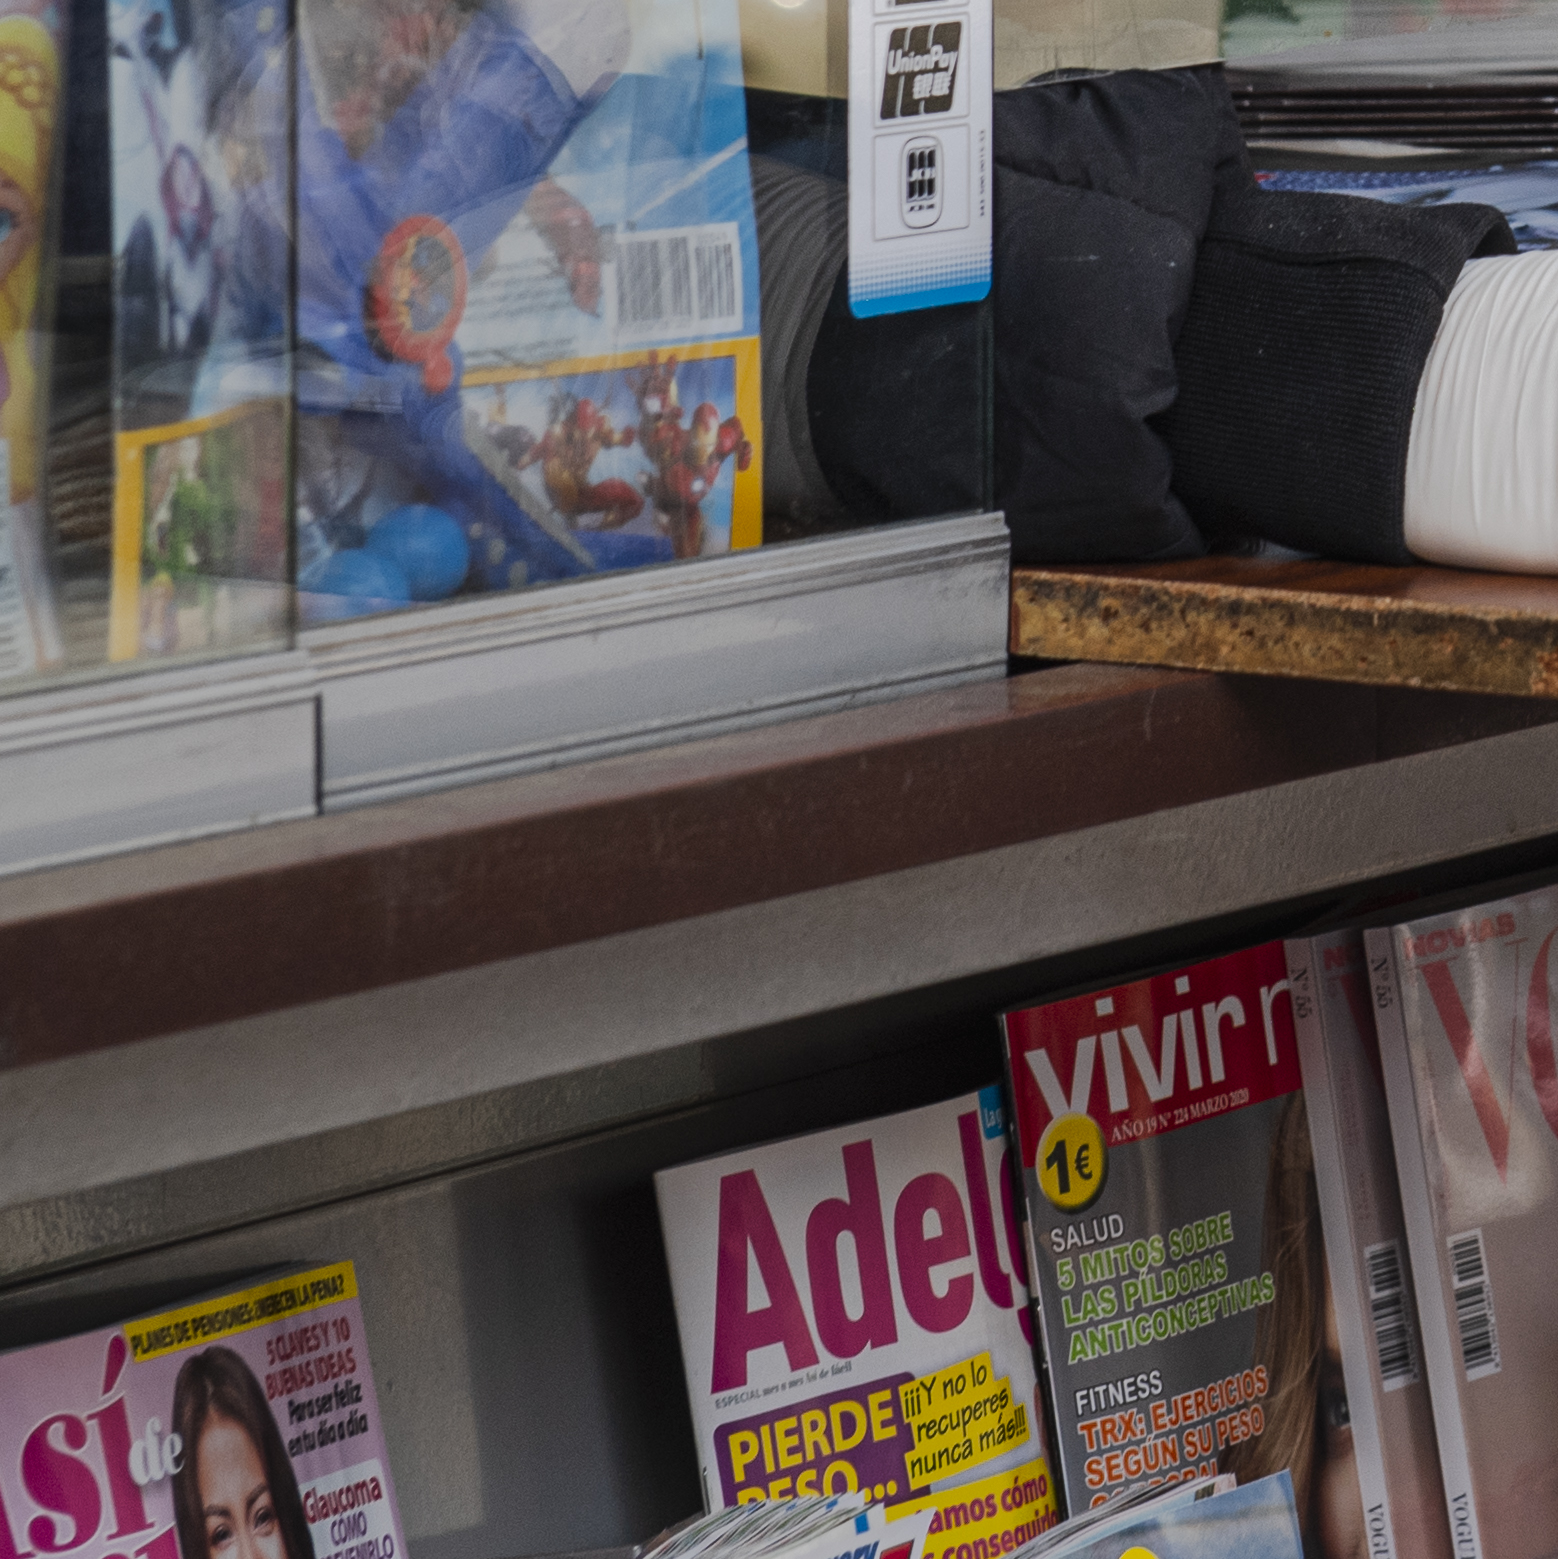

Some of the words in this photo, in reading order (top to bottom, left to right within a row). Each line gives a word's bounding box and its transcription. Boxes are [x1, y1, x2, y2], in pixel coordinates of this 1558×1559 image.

[887, 44, 959, 76] UnionPay
[1410, 912, 1517, 959] NOVIAS
[1023, 974, 1247, 1120] vivir
[1110, 1118, 1144, 1144] AÑO
[1188, 1094, 1229, 1124] MARZO
[1228, 1086, 1249, 1110] 2020
[1044, 1138, 1094, 1197] 1€
[1050, 1213, 1125, 1254] SALUD
[1056, 1256, 1077, 1292] 5
[1079, 1234, 1167, 1286] MITOS
[1168, 1211, 1234, 1261] SOBRE
[1061, 1286, 1118, 1329] LAS
[1121, 1251, 1229, 1313] PÍLDORAS
[130, 1325, 173, 1357] PLANES
[174, 1321, 192, 1346] DE
[266, 1340, 276, 1365] 5
[275, 1326, 321, 1363] CLAVES
[319, 1323, 330, 1350] Y
[331, 1316, 351, 1345] 10
[1067, 1271, 1276, 1366] ANTICONCEPTIVAS
[264, 1361, 315, 1400] BUENAS
[314, 1346, 357, 1386] IDEAS
[941, 1373, 967, 1398] no
[969, 1360, 988, 1387] lo
[1075, 1369, 1163, 1417] FITNESS
[287, 1396, 315, 1427] Para
[332, 1379, 363, 1413] feliz
[346, 1409, 369, 1439] día
[915, 1387, 1011, 1443] recuperes
[1077, 1408, 1147, 1454] TRX:
[1150, 1364, 1269, 1435] EJERCICIOS
[128, 1416, 185, 1489] de
[727, 1388, 898, 1484] PIERDE
[908, 1439, 975, 1480] nunca
[978, 1404, 1028, 1453] más!!!
[1084, 1435, 1181, 1490] SEGÚN
[1182, 1423, 1213, 1461] SU
[1214, 1403, 1265, 1451] PESO
[302, 1475, 382, 1526] Glaucoma
[914, 1500, 999, 1537] amos
[999, 1473, 1049, 1514] cómo
[330, 1510, 368, 1548] CÓMO
